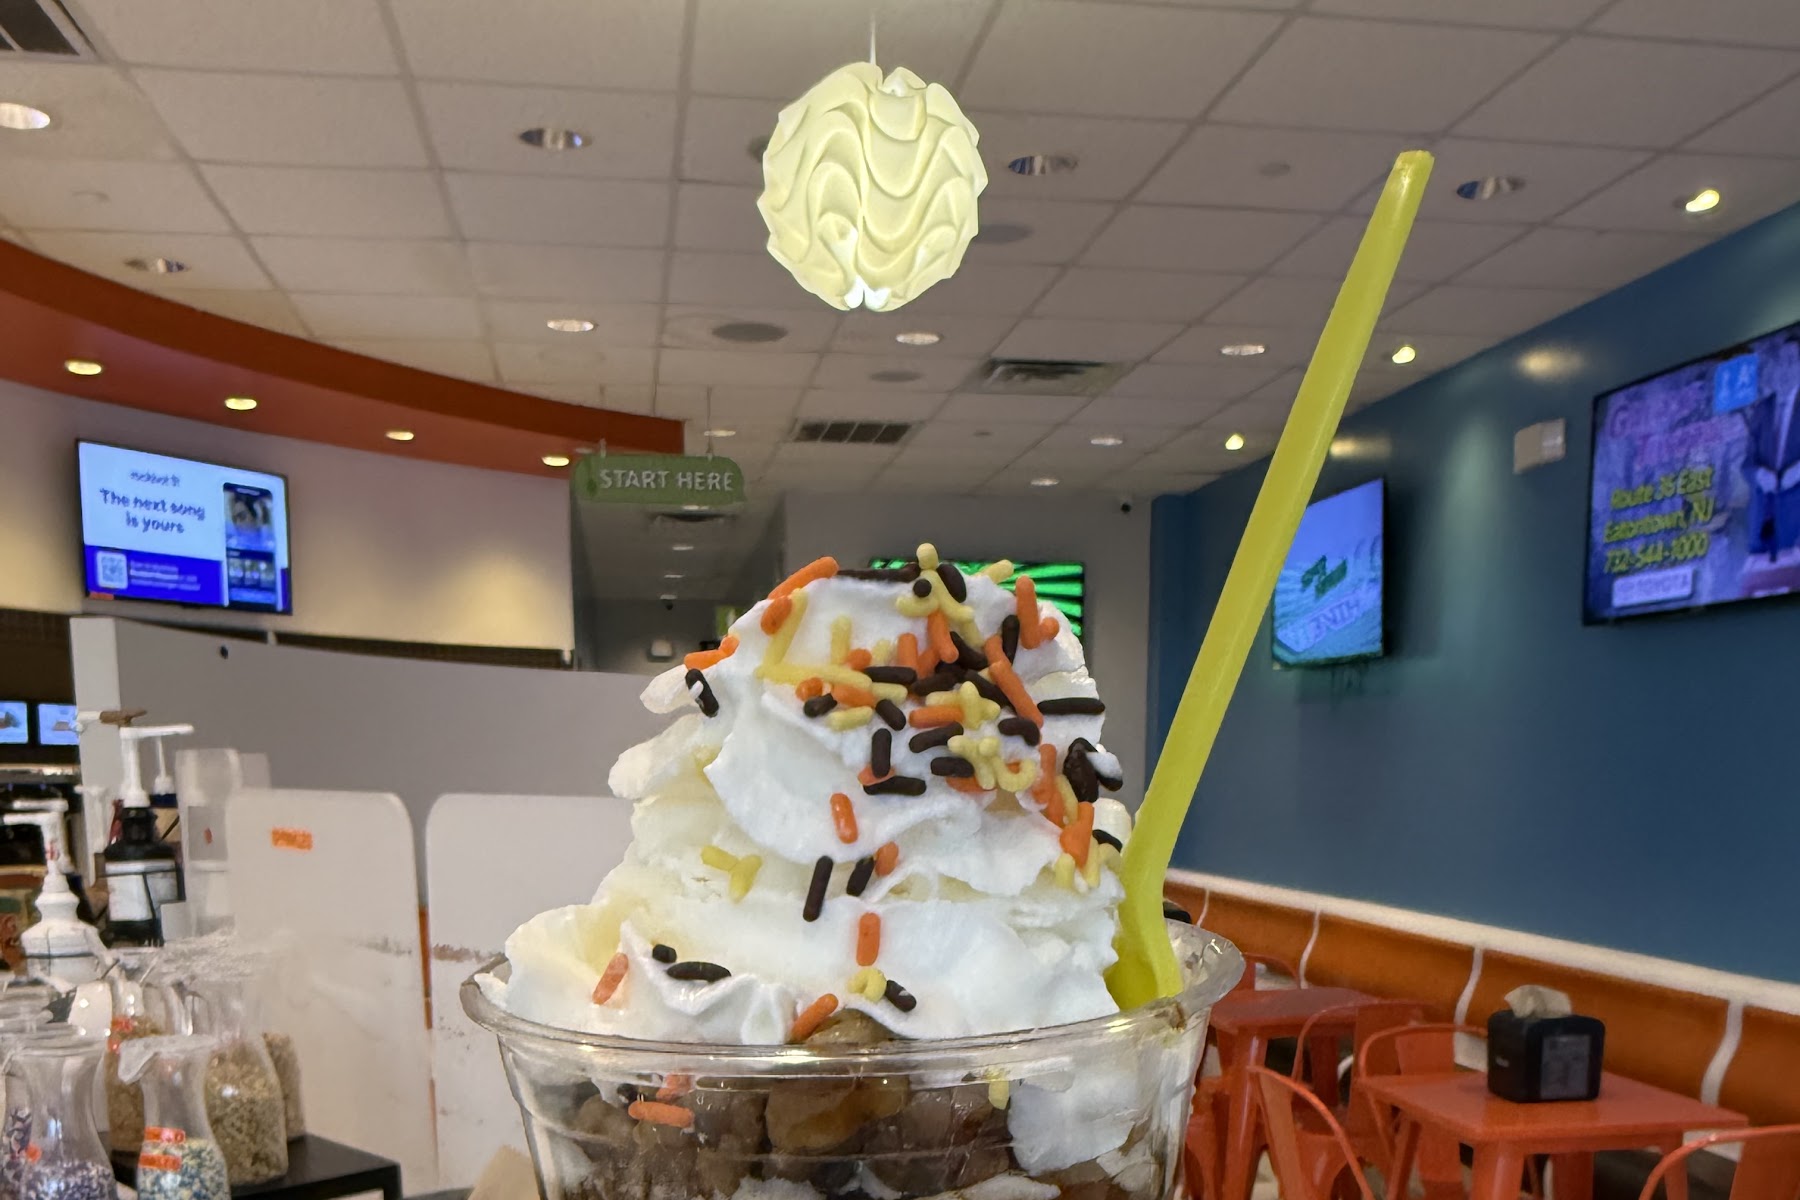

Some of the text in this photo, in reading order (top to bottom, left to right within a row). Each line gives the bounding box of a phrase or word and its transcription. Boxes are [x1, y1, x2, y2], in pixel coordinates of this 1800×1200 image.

[600, 469, 735, 491] START HERE
[99, 487, 206, 521] The next song
[142, 517, 185, 534] yours
